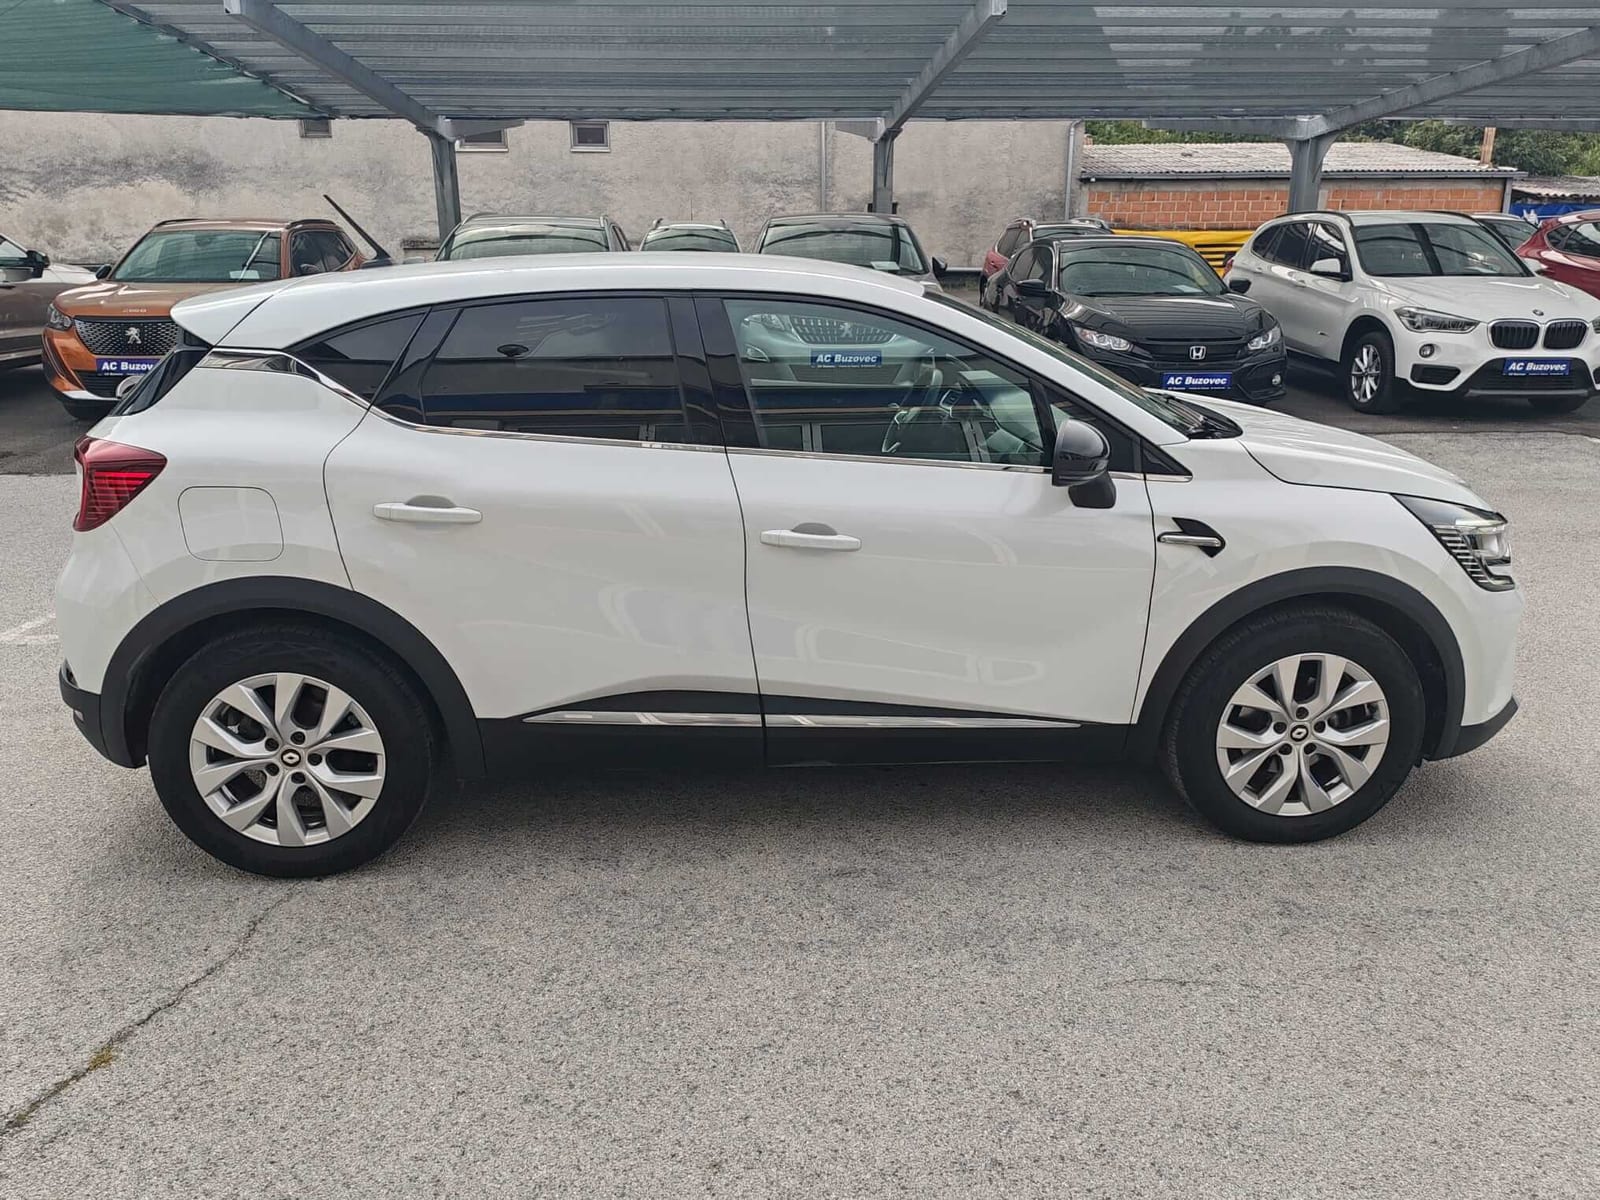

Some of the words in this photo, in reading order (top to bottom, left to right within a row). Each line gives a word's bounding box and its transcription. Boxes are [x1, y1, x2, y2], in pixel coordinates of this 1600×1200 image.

[816, 354, 832, 363] AC
[834, 354, 877, 363] Buzovec
[102, 361, 117, 370] AC
[120, 361, 153, 370] Buzov
[1508, 362, 1525, 371] AC
[1526, 362, 1567, 371] Buzovec
[1167, 376, 1183, 385] AC
[1184, 376, 1227, 385] Buzovec
